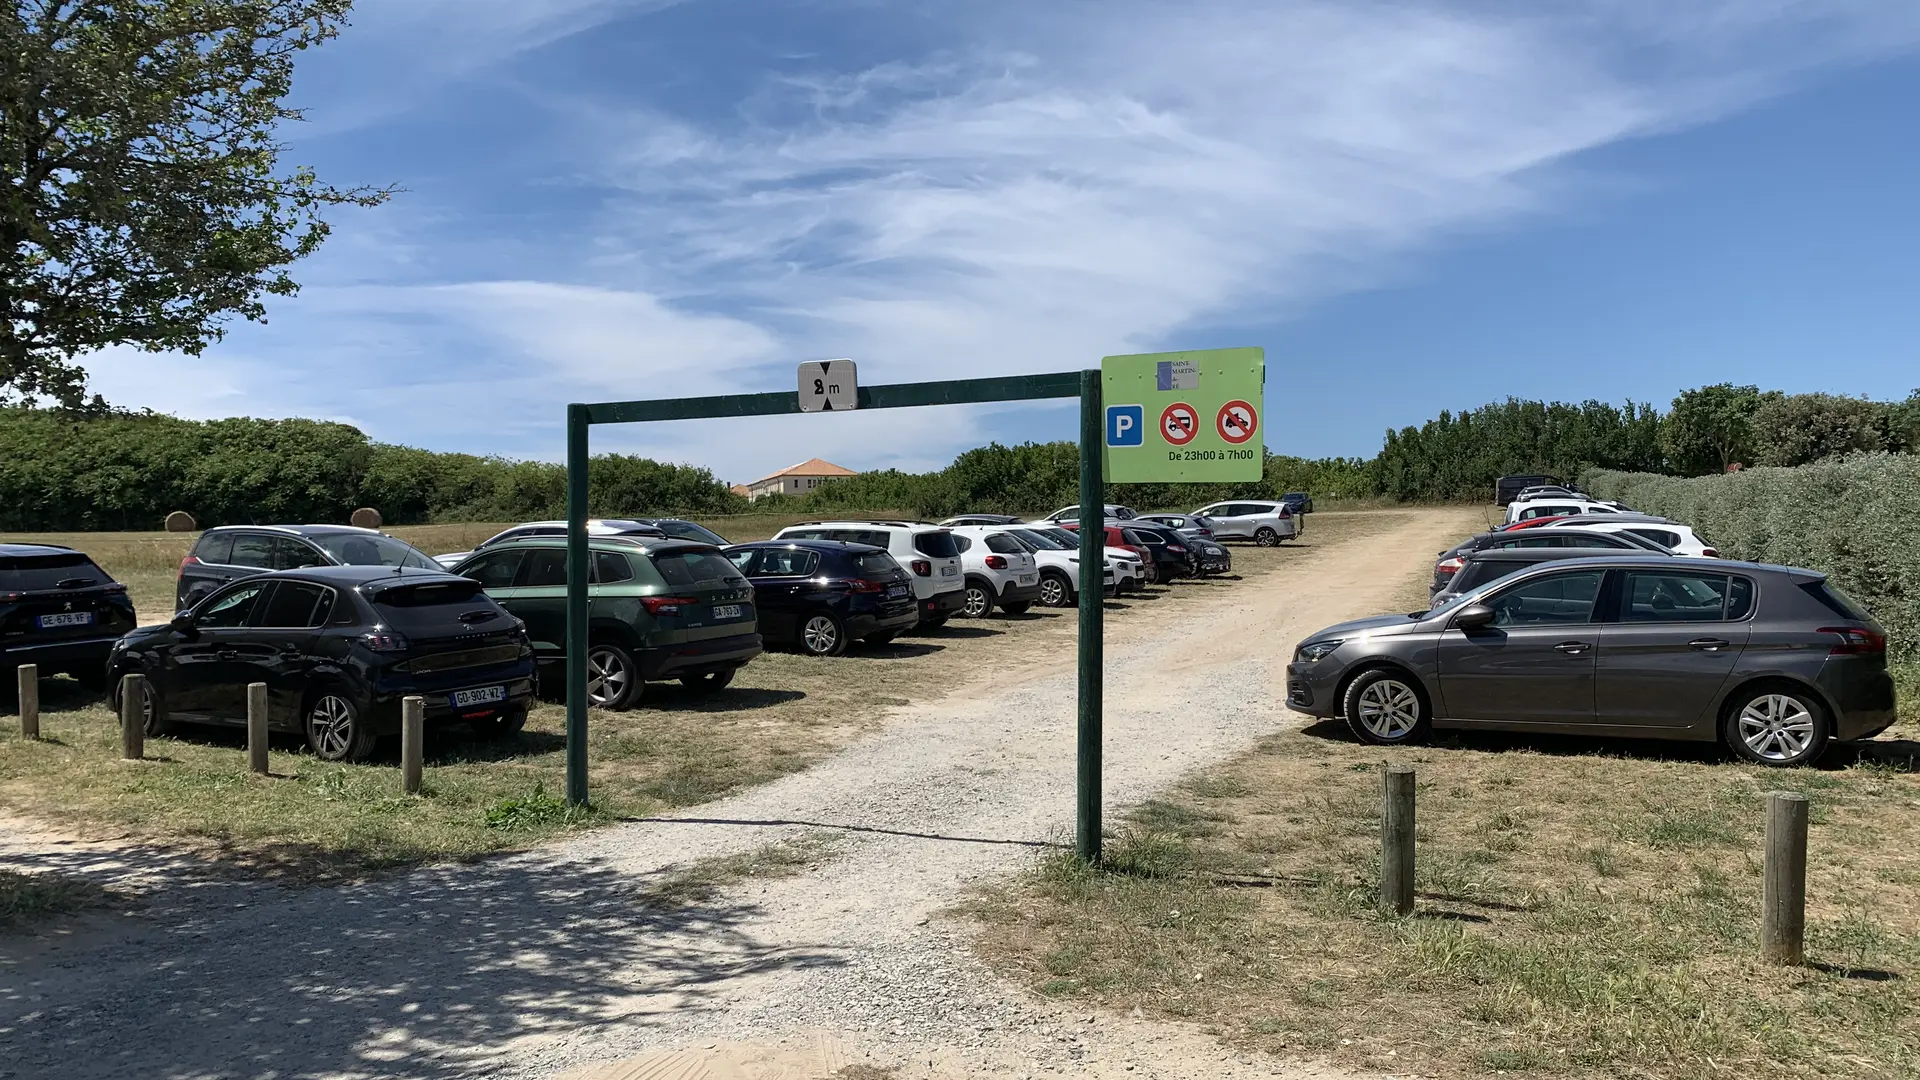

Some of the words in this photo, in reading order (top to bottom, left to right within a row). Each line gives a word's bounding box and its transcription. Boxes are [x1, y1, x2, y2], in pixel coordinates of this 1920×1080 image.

[828, 384, 840, 394] m
[1116, 415, 1133, 438] P
[1168, 451, 1182, 461] De
[1184, 450, 1216, 461] 23h00
[1218, 449, 1225, 460] à
[1227, 449, 1254, 460] 7h00
